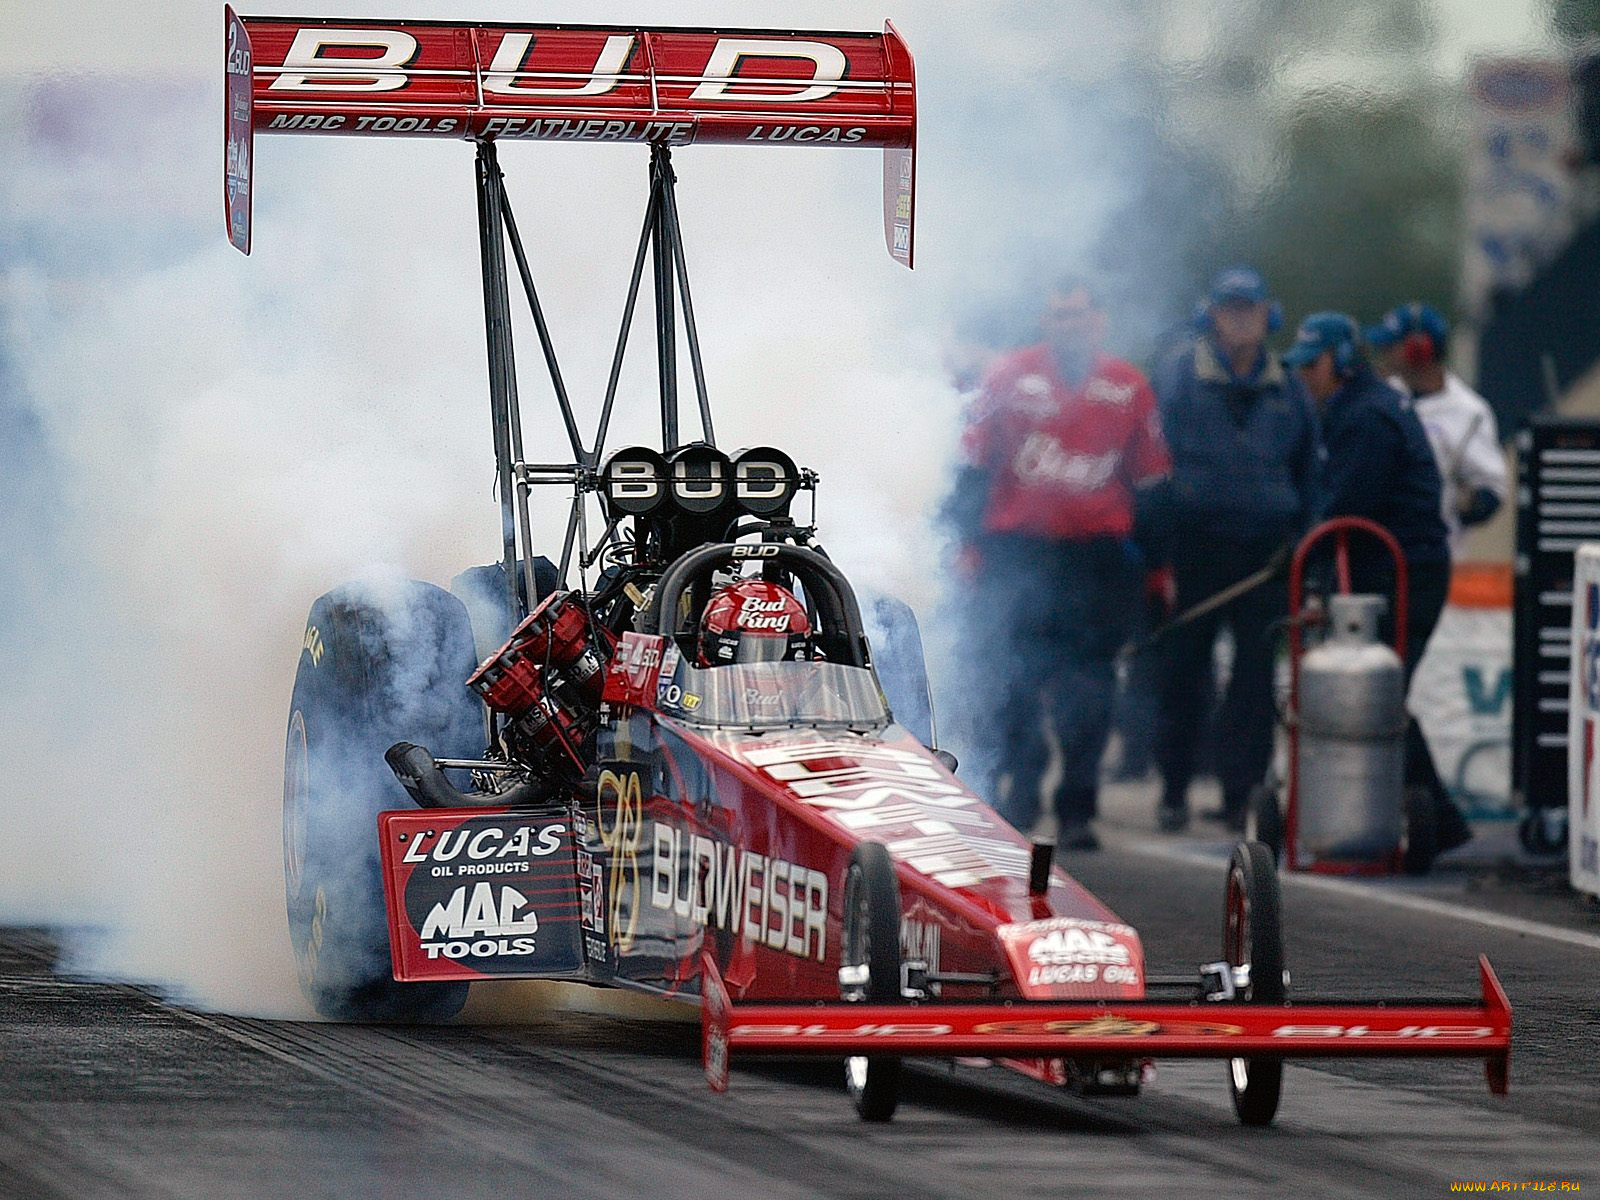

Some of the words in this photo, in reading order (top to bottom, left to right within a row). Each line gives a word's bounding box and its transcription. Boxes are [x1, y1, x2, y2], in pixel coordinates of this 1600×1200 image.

[268, 28, 849, 101] BUD
[268, 114, 346, 132] MAC
[356, 116, 458, 133] TOOLS
[480, 118, 692, 142] FEATHERLITE
[746, 126, 867, 143] LUCAS
[611, 461, 786, 499] BUD
[731, 545, 780, 557] BUD
[741, 597, 786, 612] Bud
[737, 610, 791, 632] King
[402, 824, 566, 863] LUCAS
[431, 864, 454, 877] OIL
[458, 861, 530, 876] PRODUCTS
[652, 821, 829, 963] BUDWEISER
[420, 882, 539, 940] MAC
[420, 938, 536, 960] TOOLS
[1028, 964, 1099, 986] LUCAS
